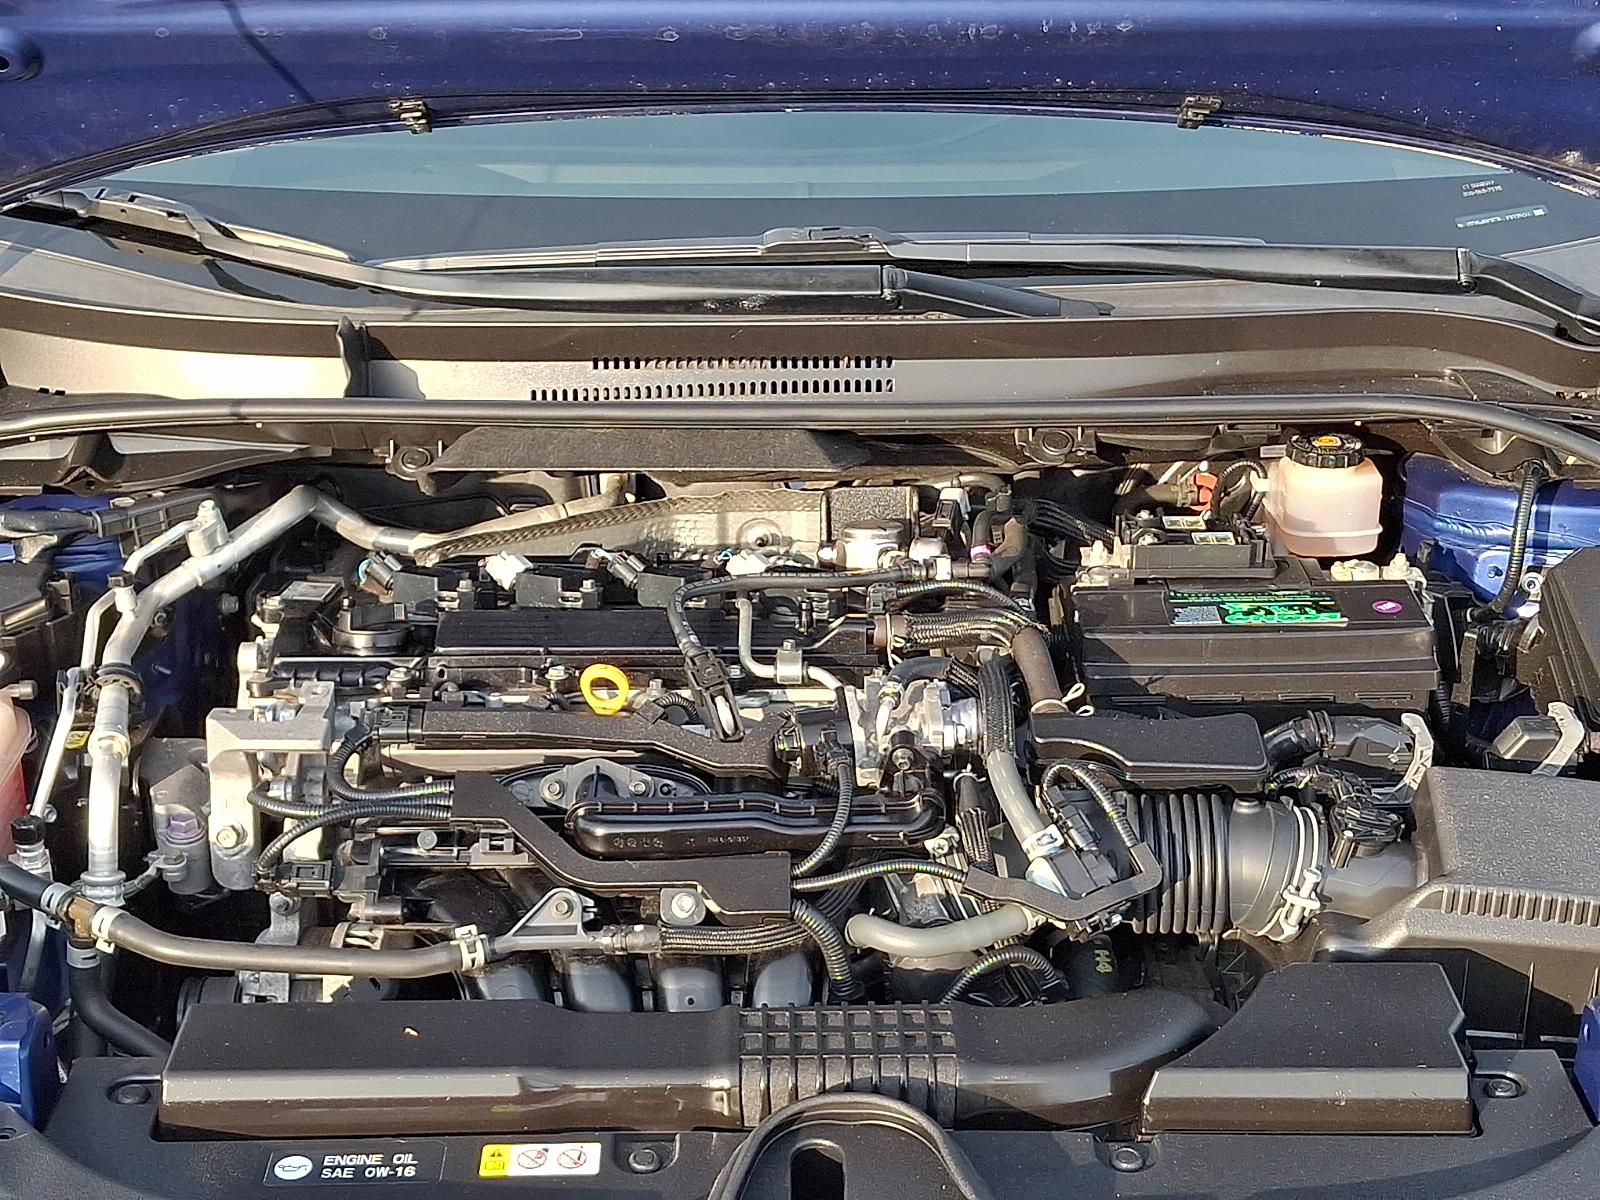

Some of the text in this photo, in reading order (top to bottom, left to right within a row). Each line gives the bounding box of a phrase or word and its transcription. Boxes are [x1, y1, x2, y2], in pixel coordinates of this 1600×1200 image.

[323, 1153, 419, 1165] ENGINE OIL
[320, 1166, 416, 1178] SAE 0W-16
